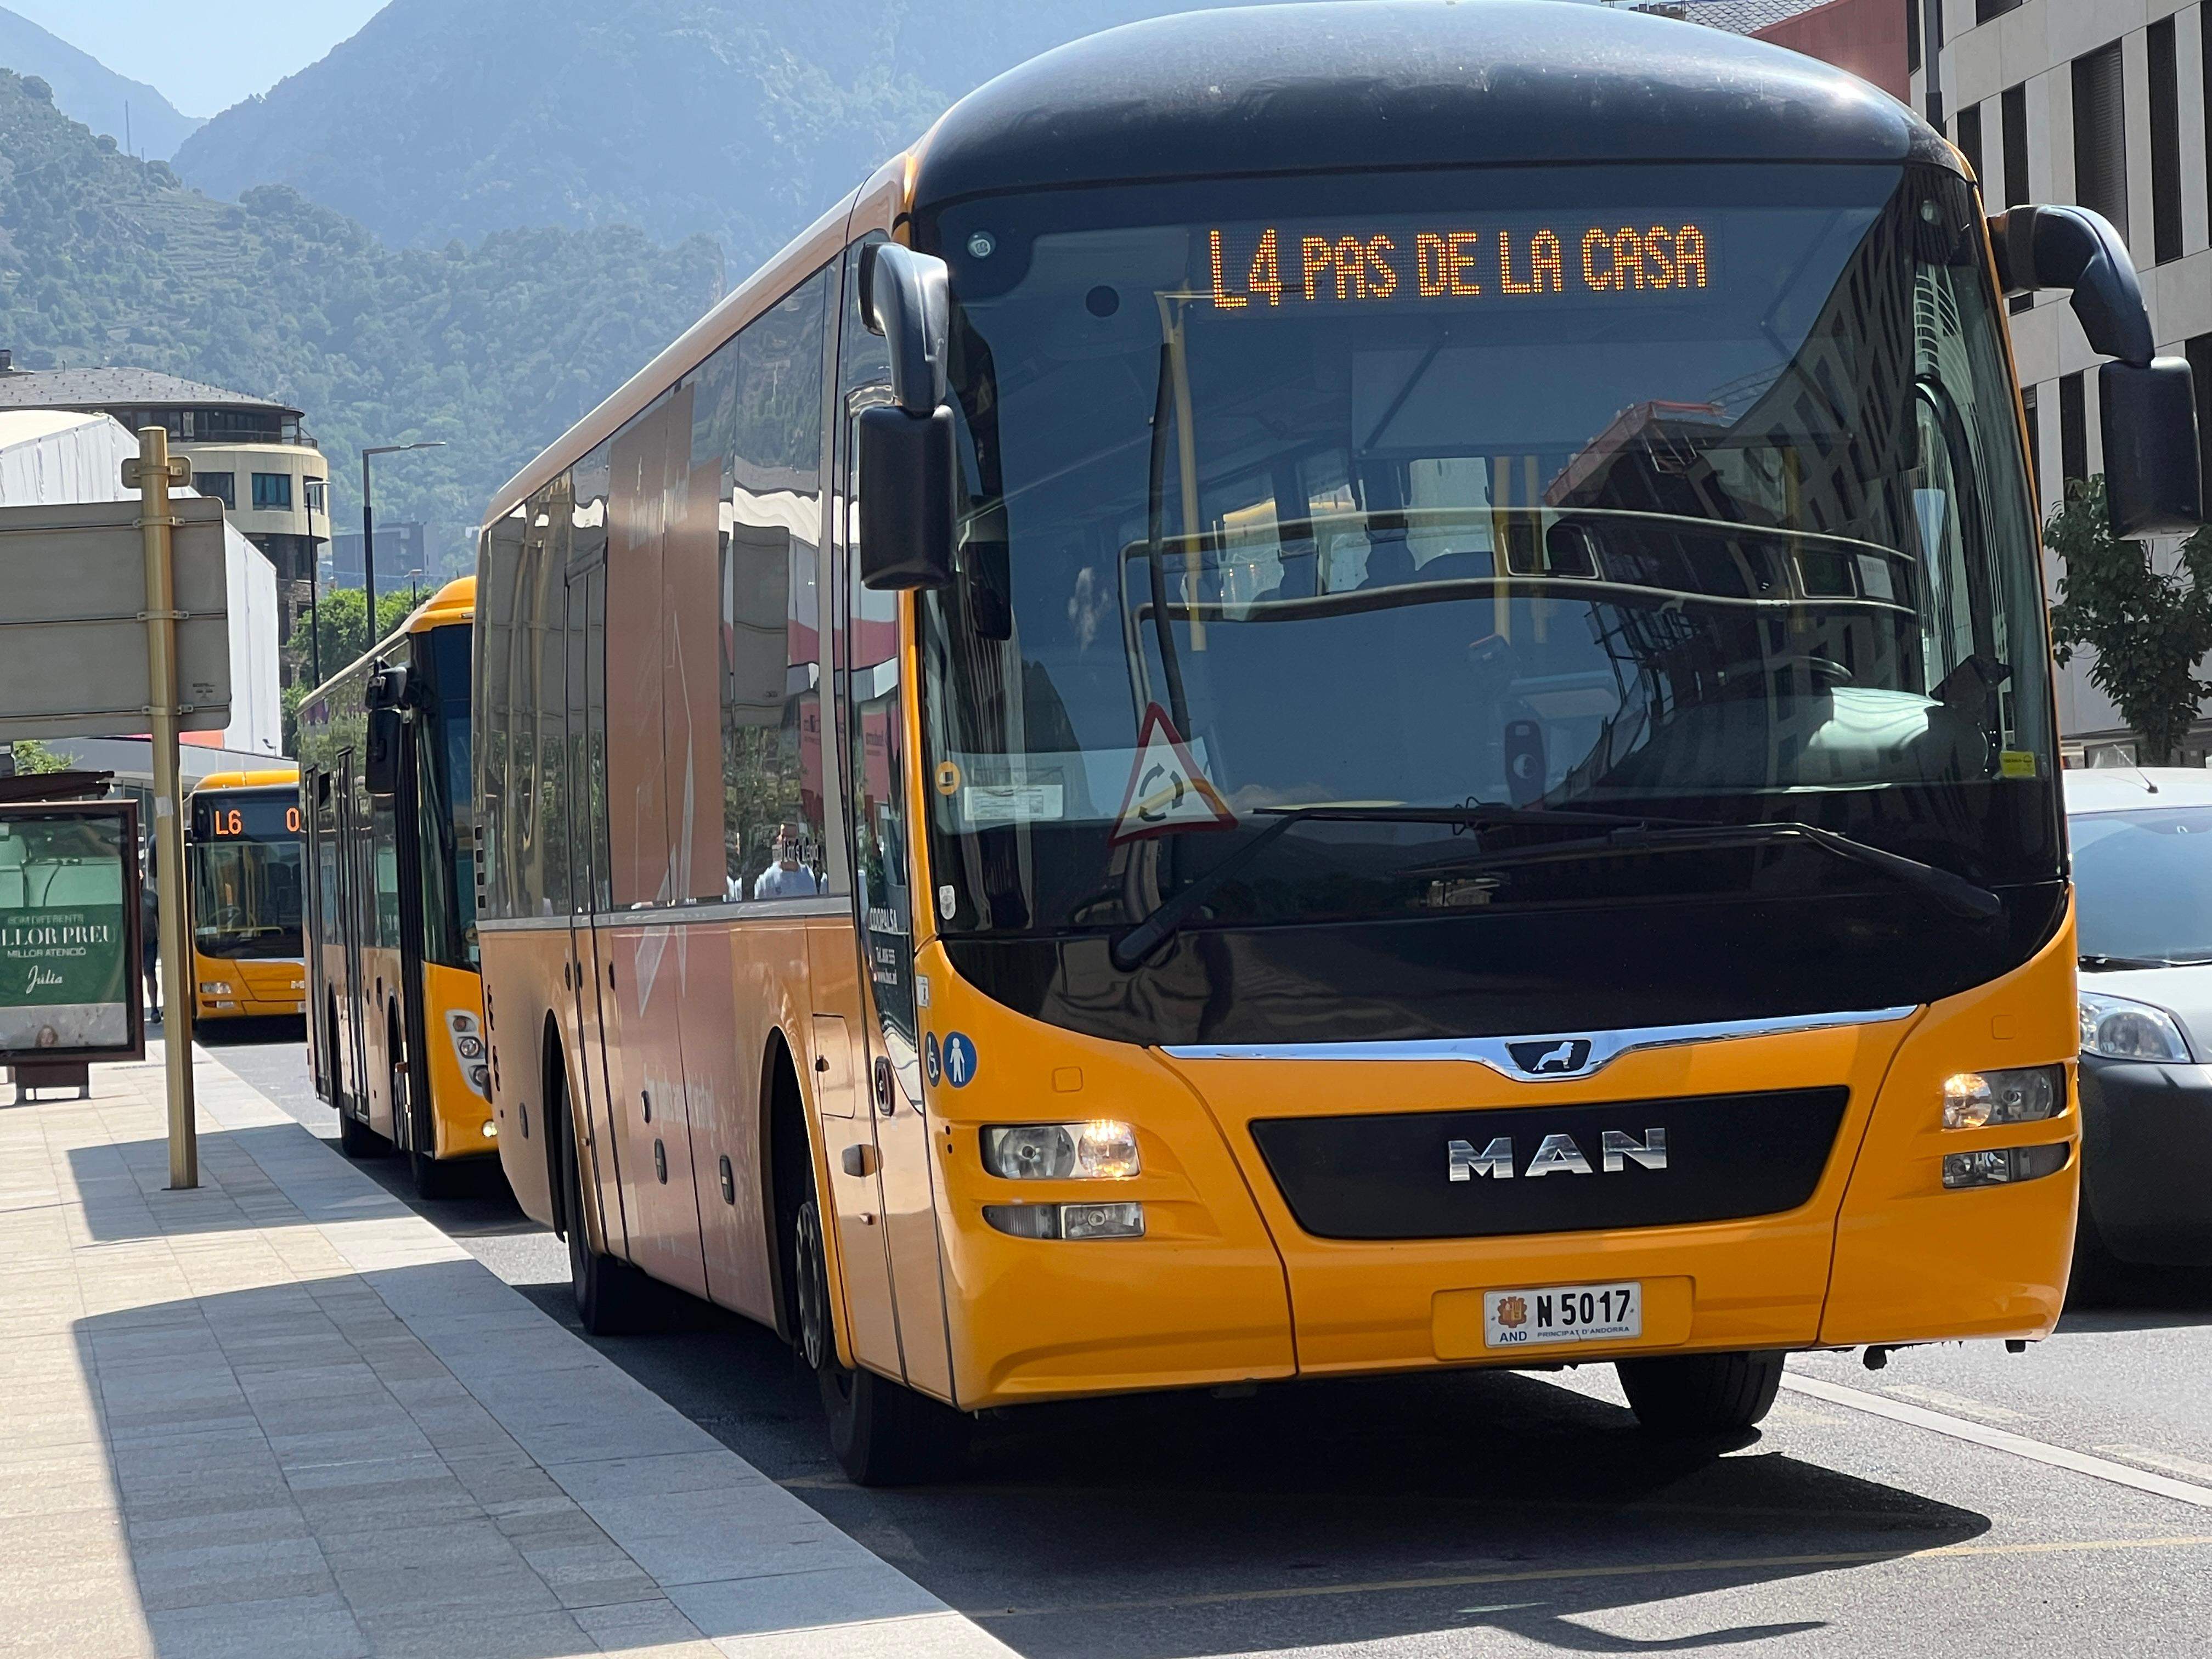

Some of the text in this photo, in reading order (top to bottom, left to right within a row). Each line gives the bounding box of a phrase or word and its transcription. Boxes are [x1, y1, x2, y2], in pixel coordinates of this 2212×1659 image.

[1210, 224, 1707, 308] L4 PAS DE LA CASA
[215, 809, 242, 835] L6
[63, 925, 116, 944] PREU
[8, 949, 43, 957] MILLOR
[1448, 1127, 1667, 1181] MAN
[1537, 1289, 1630, 1328] N 5017
[1499, 1331, 1527, 1342] AND
[1582, 1327, 1629, 1335] D'ANDORRA
